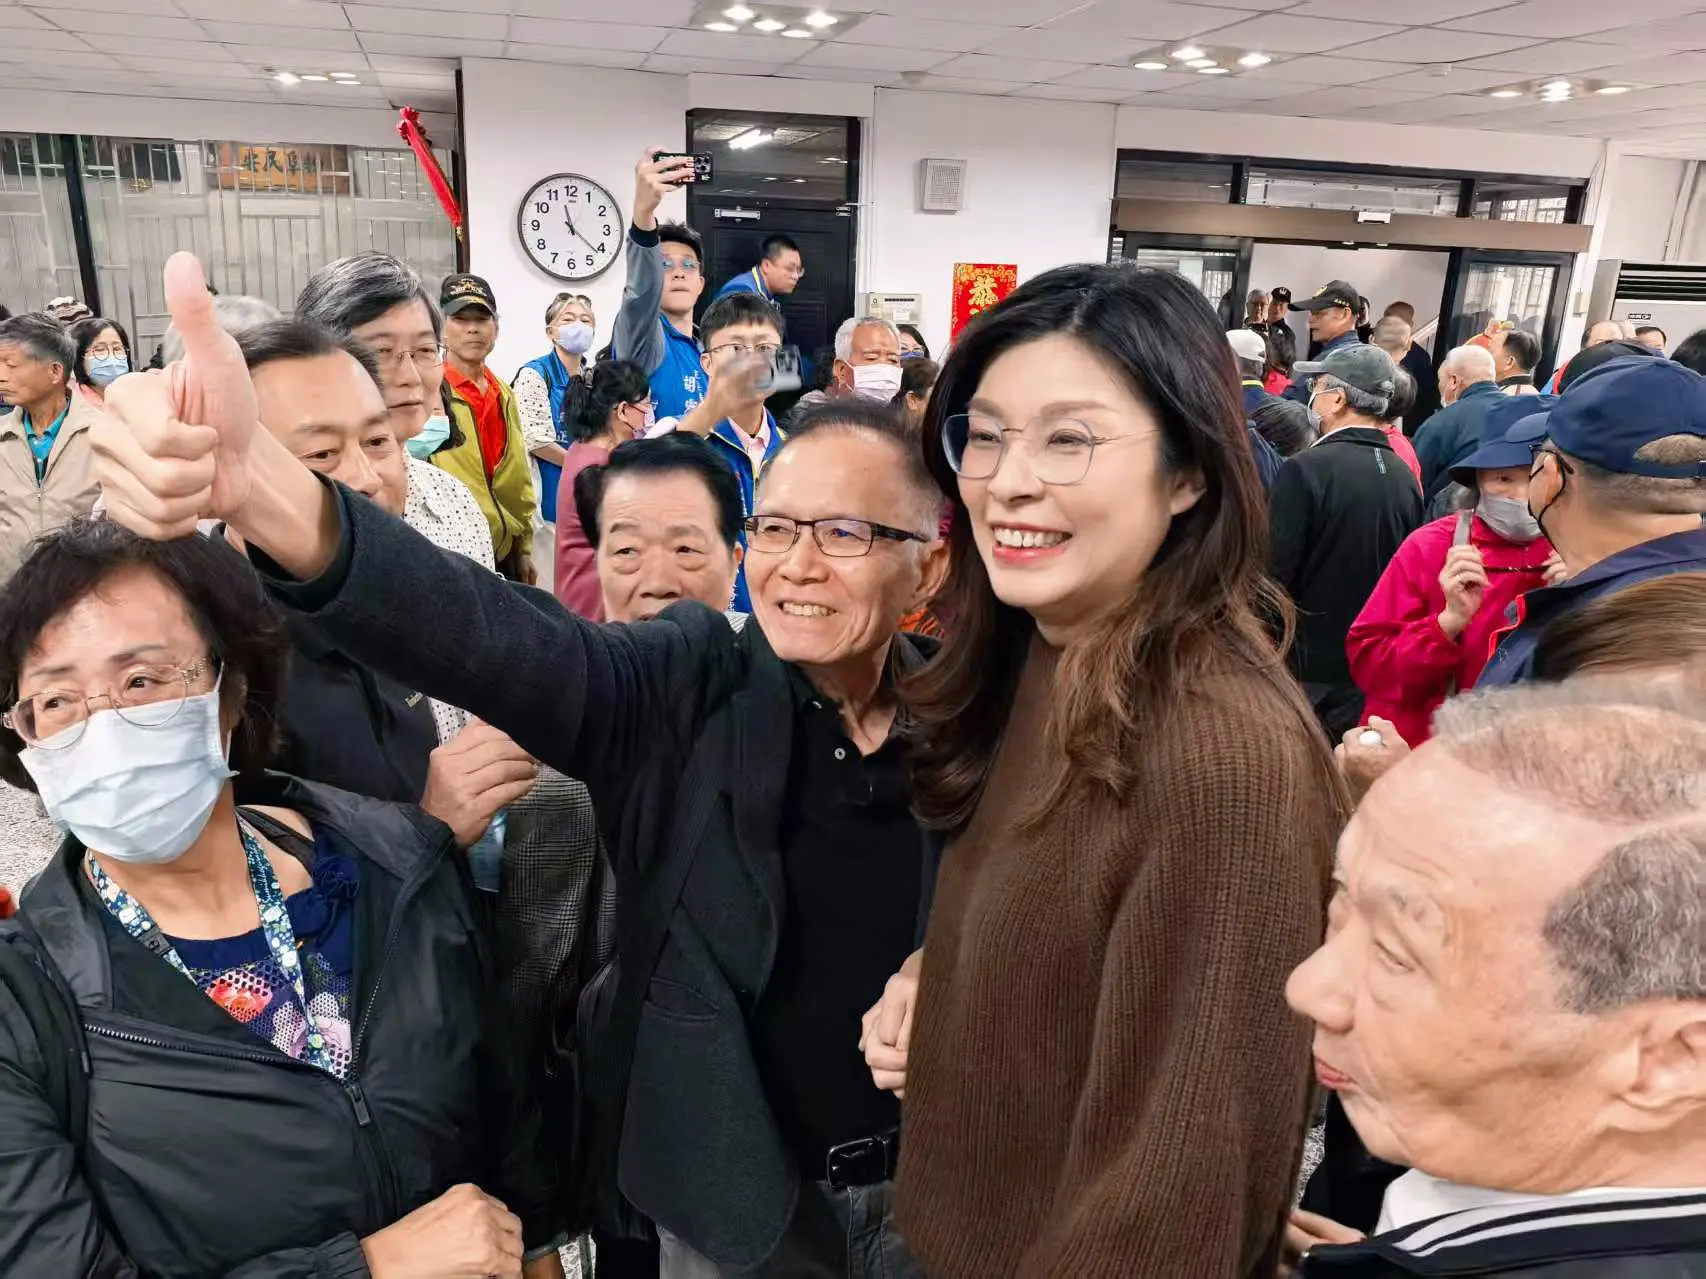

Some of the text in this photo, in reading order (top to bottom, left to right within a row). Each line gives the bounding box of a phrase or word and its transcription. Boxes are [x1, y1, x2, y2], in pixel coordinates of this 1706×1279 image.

[546, 189, 559, 201] 11
[563, 185, 578, 197] 12
[585, 191, 591, 203] 1
[535, 202, 550, 214] 10
[598, 205, 607, 217] 2
[531, 219, 541, 231] 9
[603, 224, 611, 236] 3
[537, 239, 546, 250] 8
[597, 242, 606, 254] 4
[550, 252, 559, 264] 7
[567, 258, 576, 270] 6
[585, 254, 594, 266] 5
